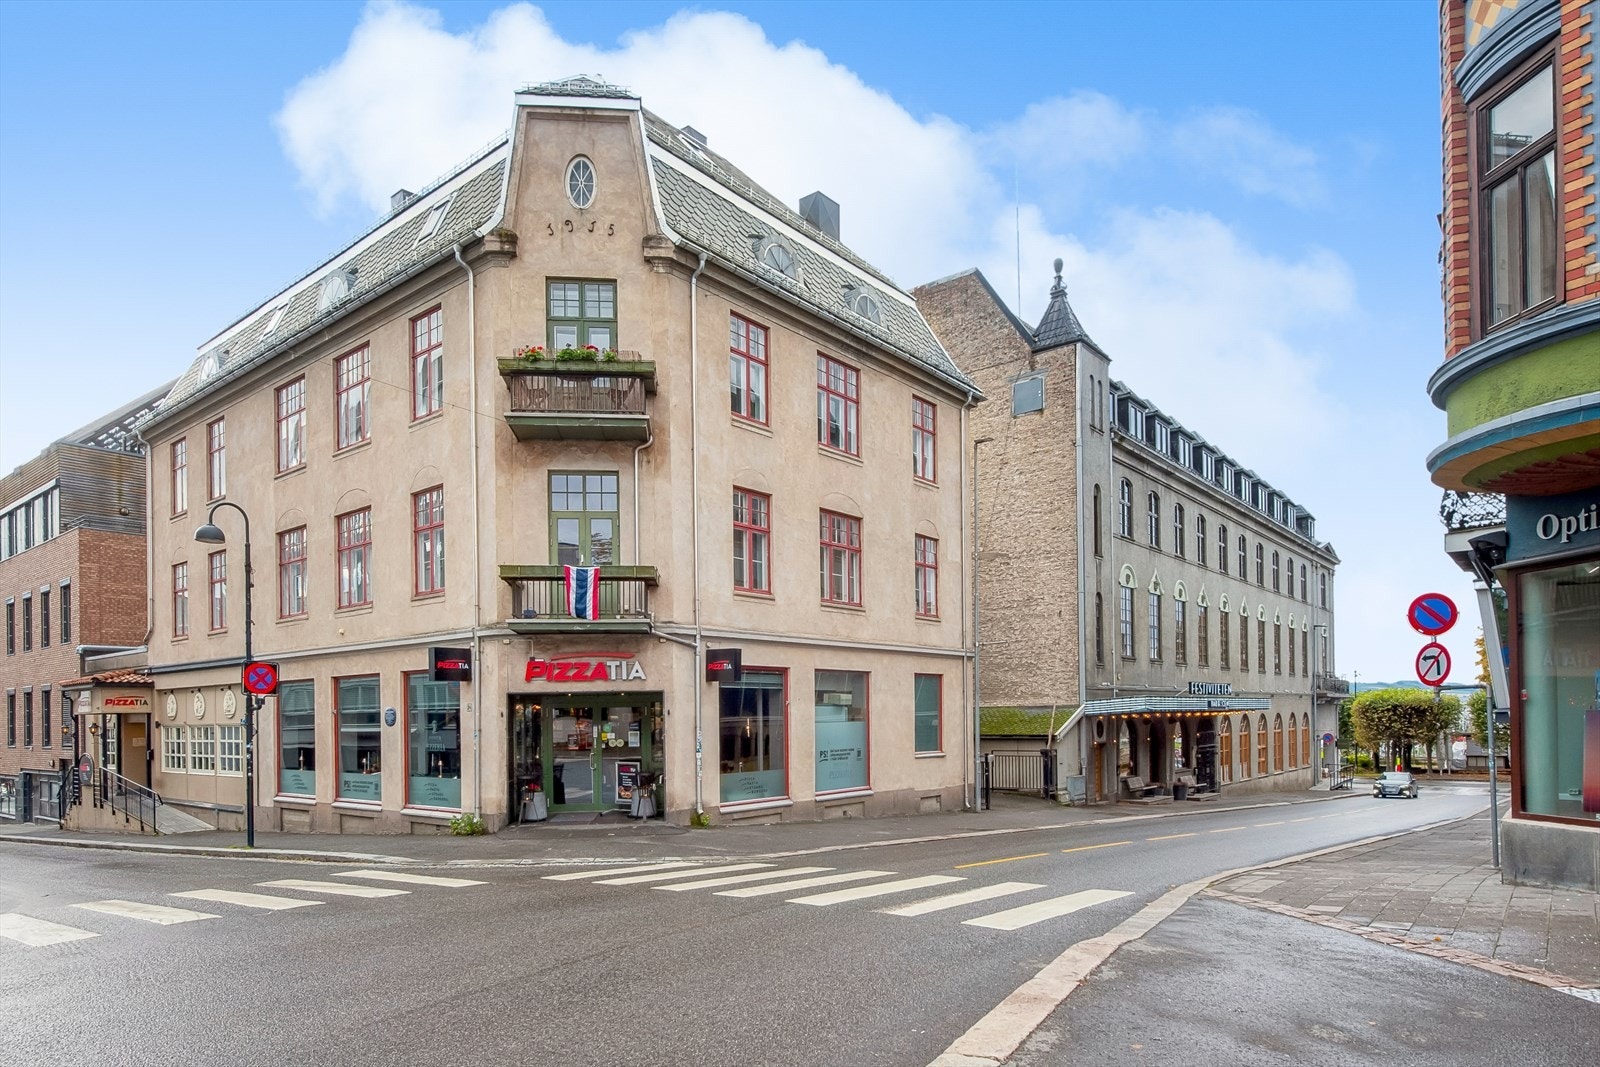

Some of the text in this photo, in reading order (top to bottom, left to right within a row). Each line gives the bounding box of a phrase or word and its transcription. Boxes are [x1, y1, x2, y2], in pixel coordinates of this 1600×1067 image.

[1536, 504, 1600, 543] Opti
[437, 661, 469, 669] PIZZATIA
[707, 663, 732, 671] PIZZATIA
[524, 659, 647, 682] PIZZATIA
[1191, 682, 1232, 695] FESTIVITETEN
[104, 698, 149, 706] PIZZATIA
[819, 750, 829, 758] PS!
